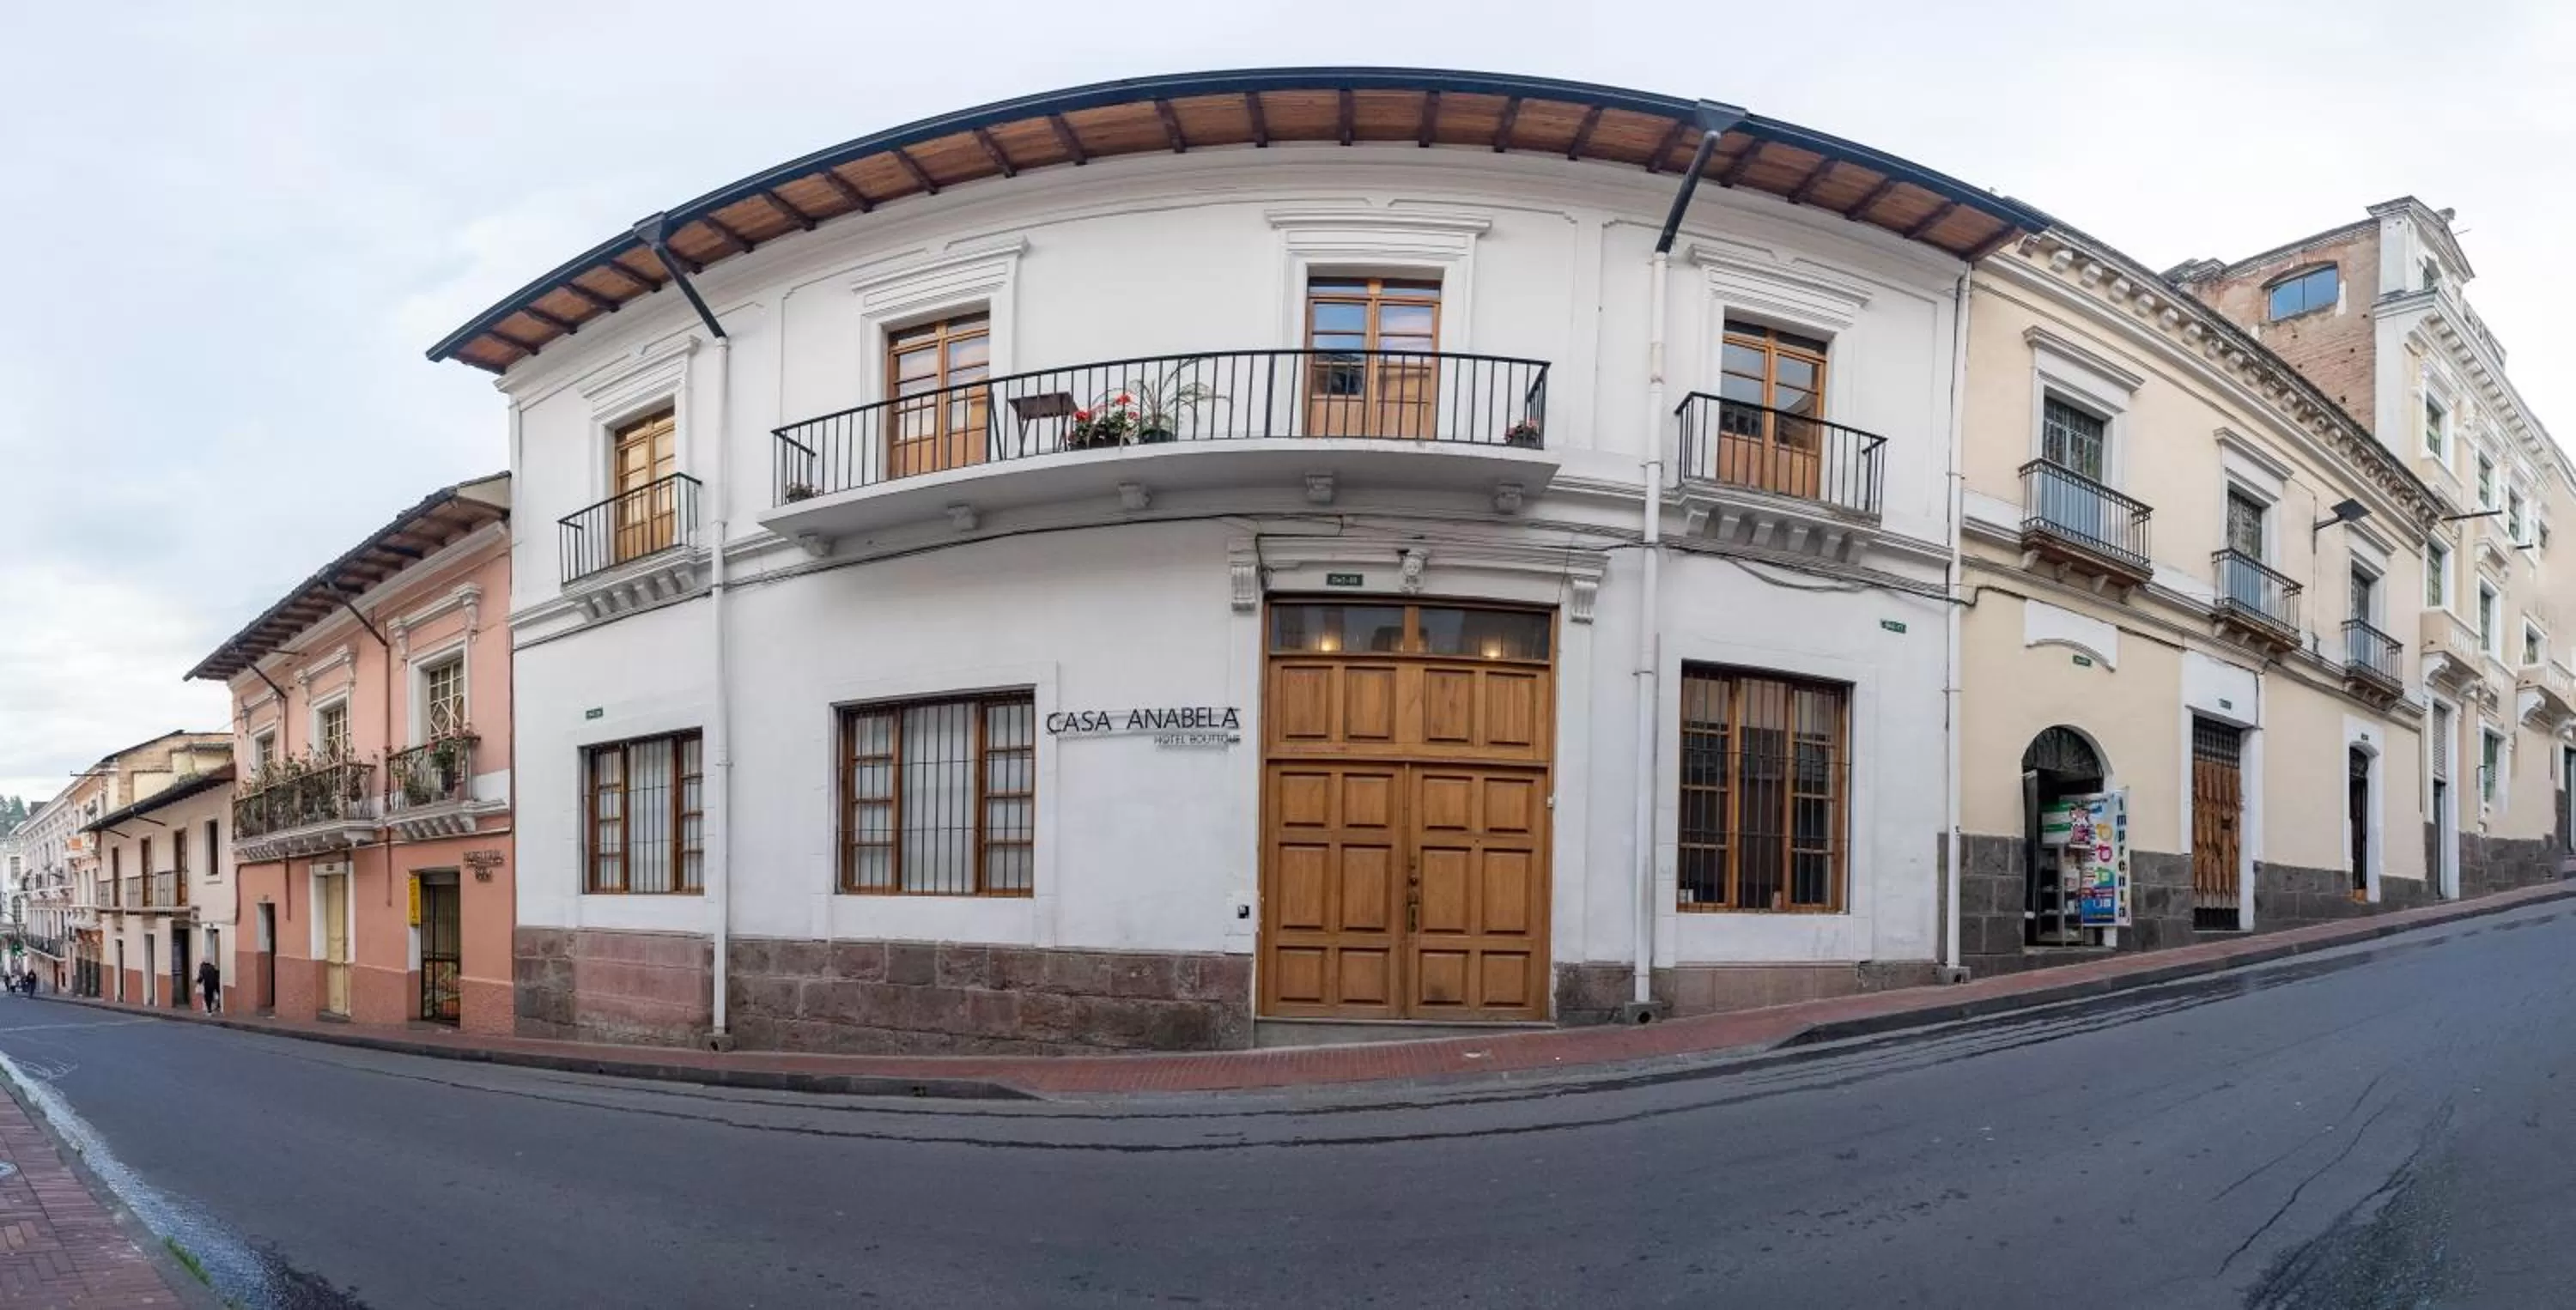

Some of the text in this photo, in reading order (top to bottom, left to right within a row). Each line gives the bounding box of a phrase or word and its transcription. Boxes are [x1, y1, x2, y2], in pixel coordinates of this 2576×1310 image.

[1046, 707, 1240, 734] CASA ANABELA
[1154, 734, 1185, 744] HOTEL
